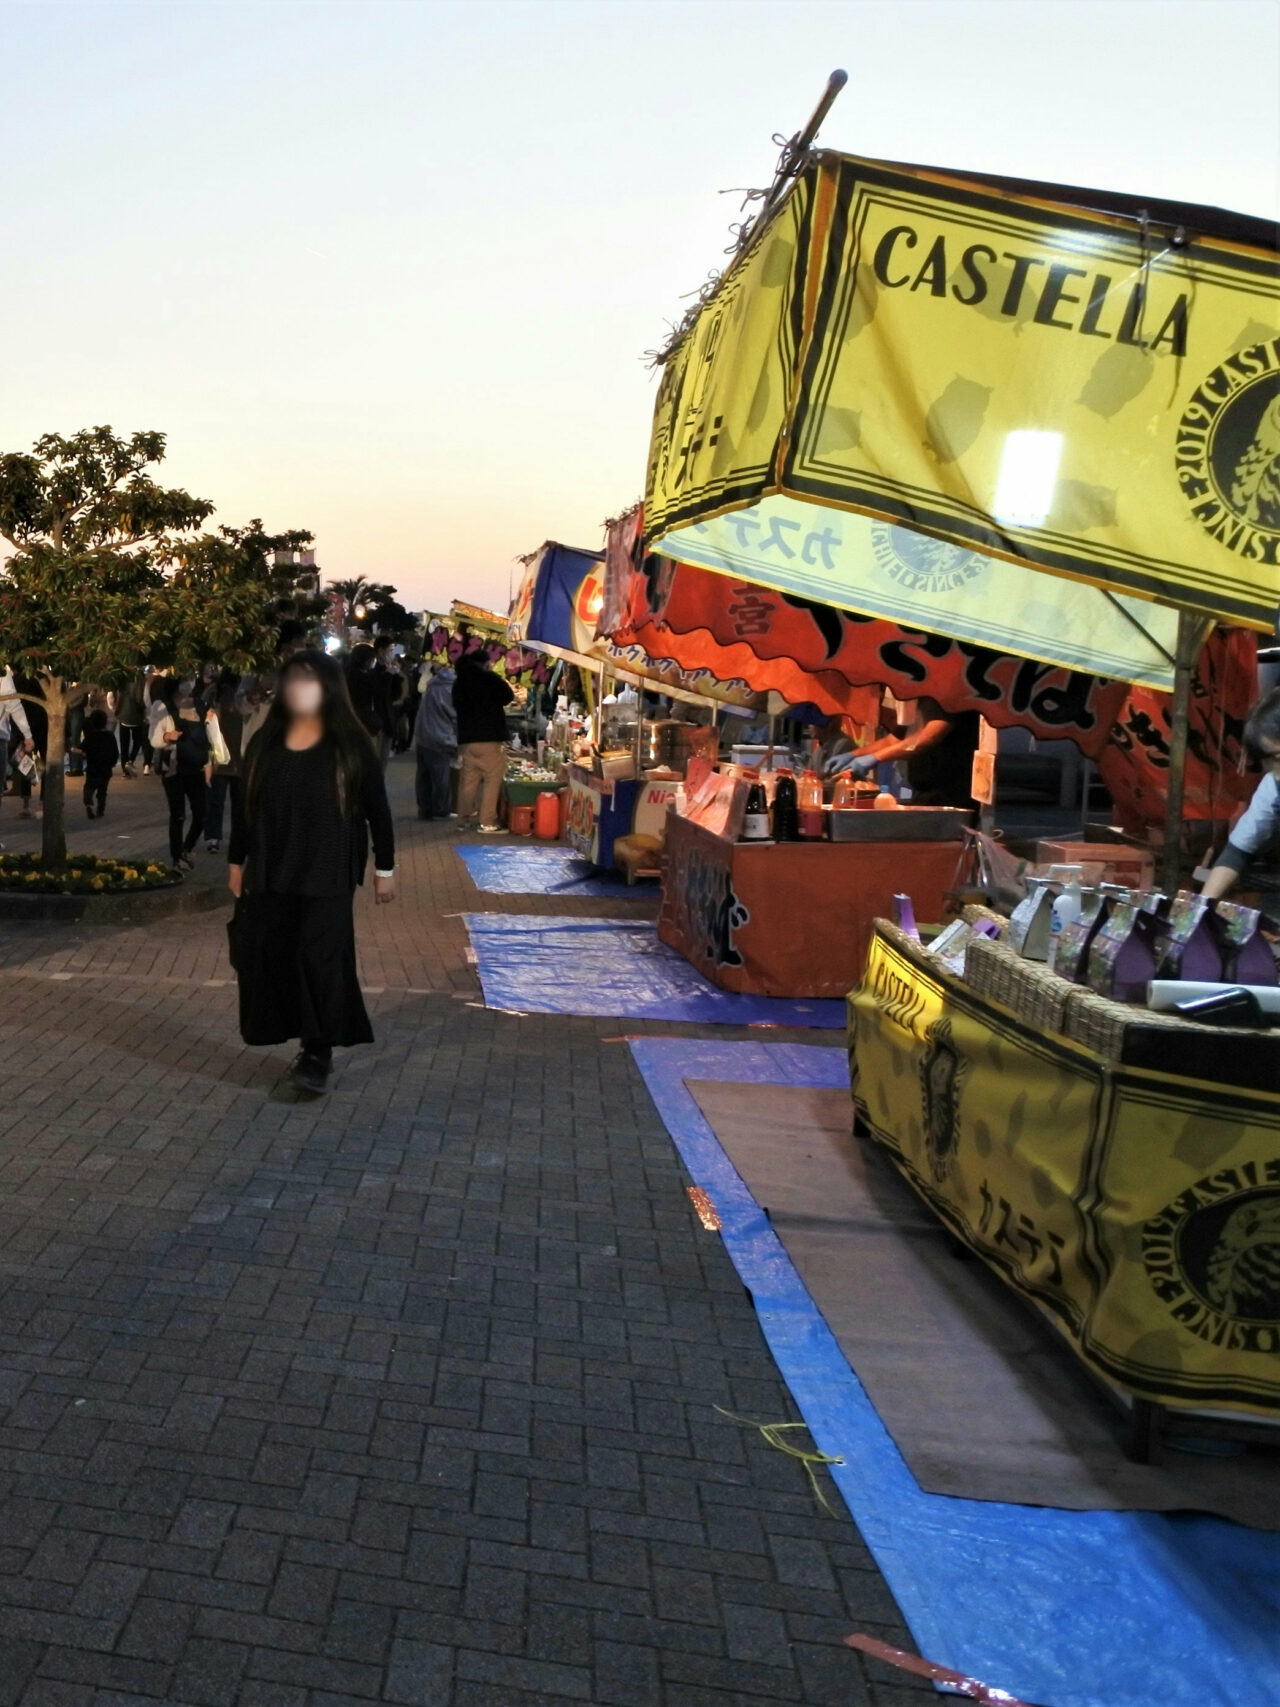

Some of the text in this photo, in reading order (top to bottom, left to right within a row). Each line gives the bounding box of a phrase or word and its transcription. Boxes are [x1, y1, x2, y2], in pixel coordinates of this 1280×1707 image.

[873, 225, 1187, 357] CASTELLA
[1174, 402, 1212, 485] 2019
[978, 1178, 1066, 1287] カステラ
